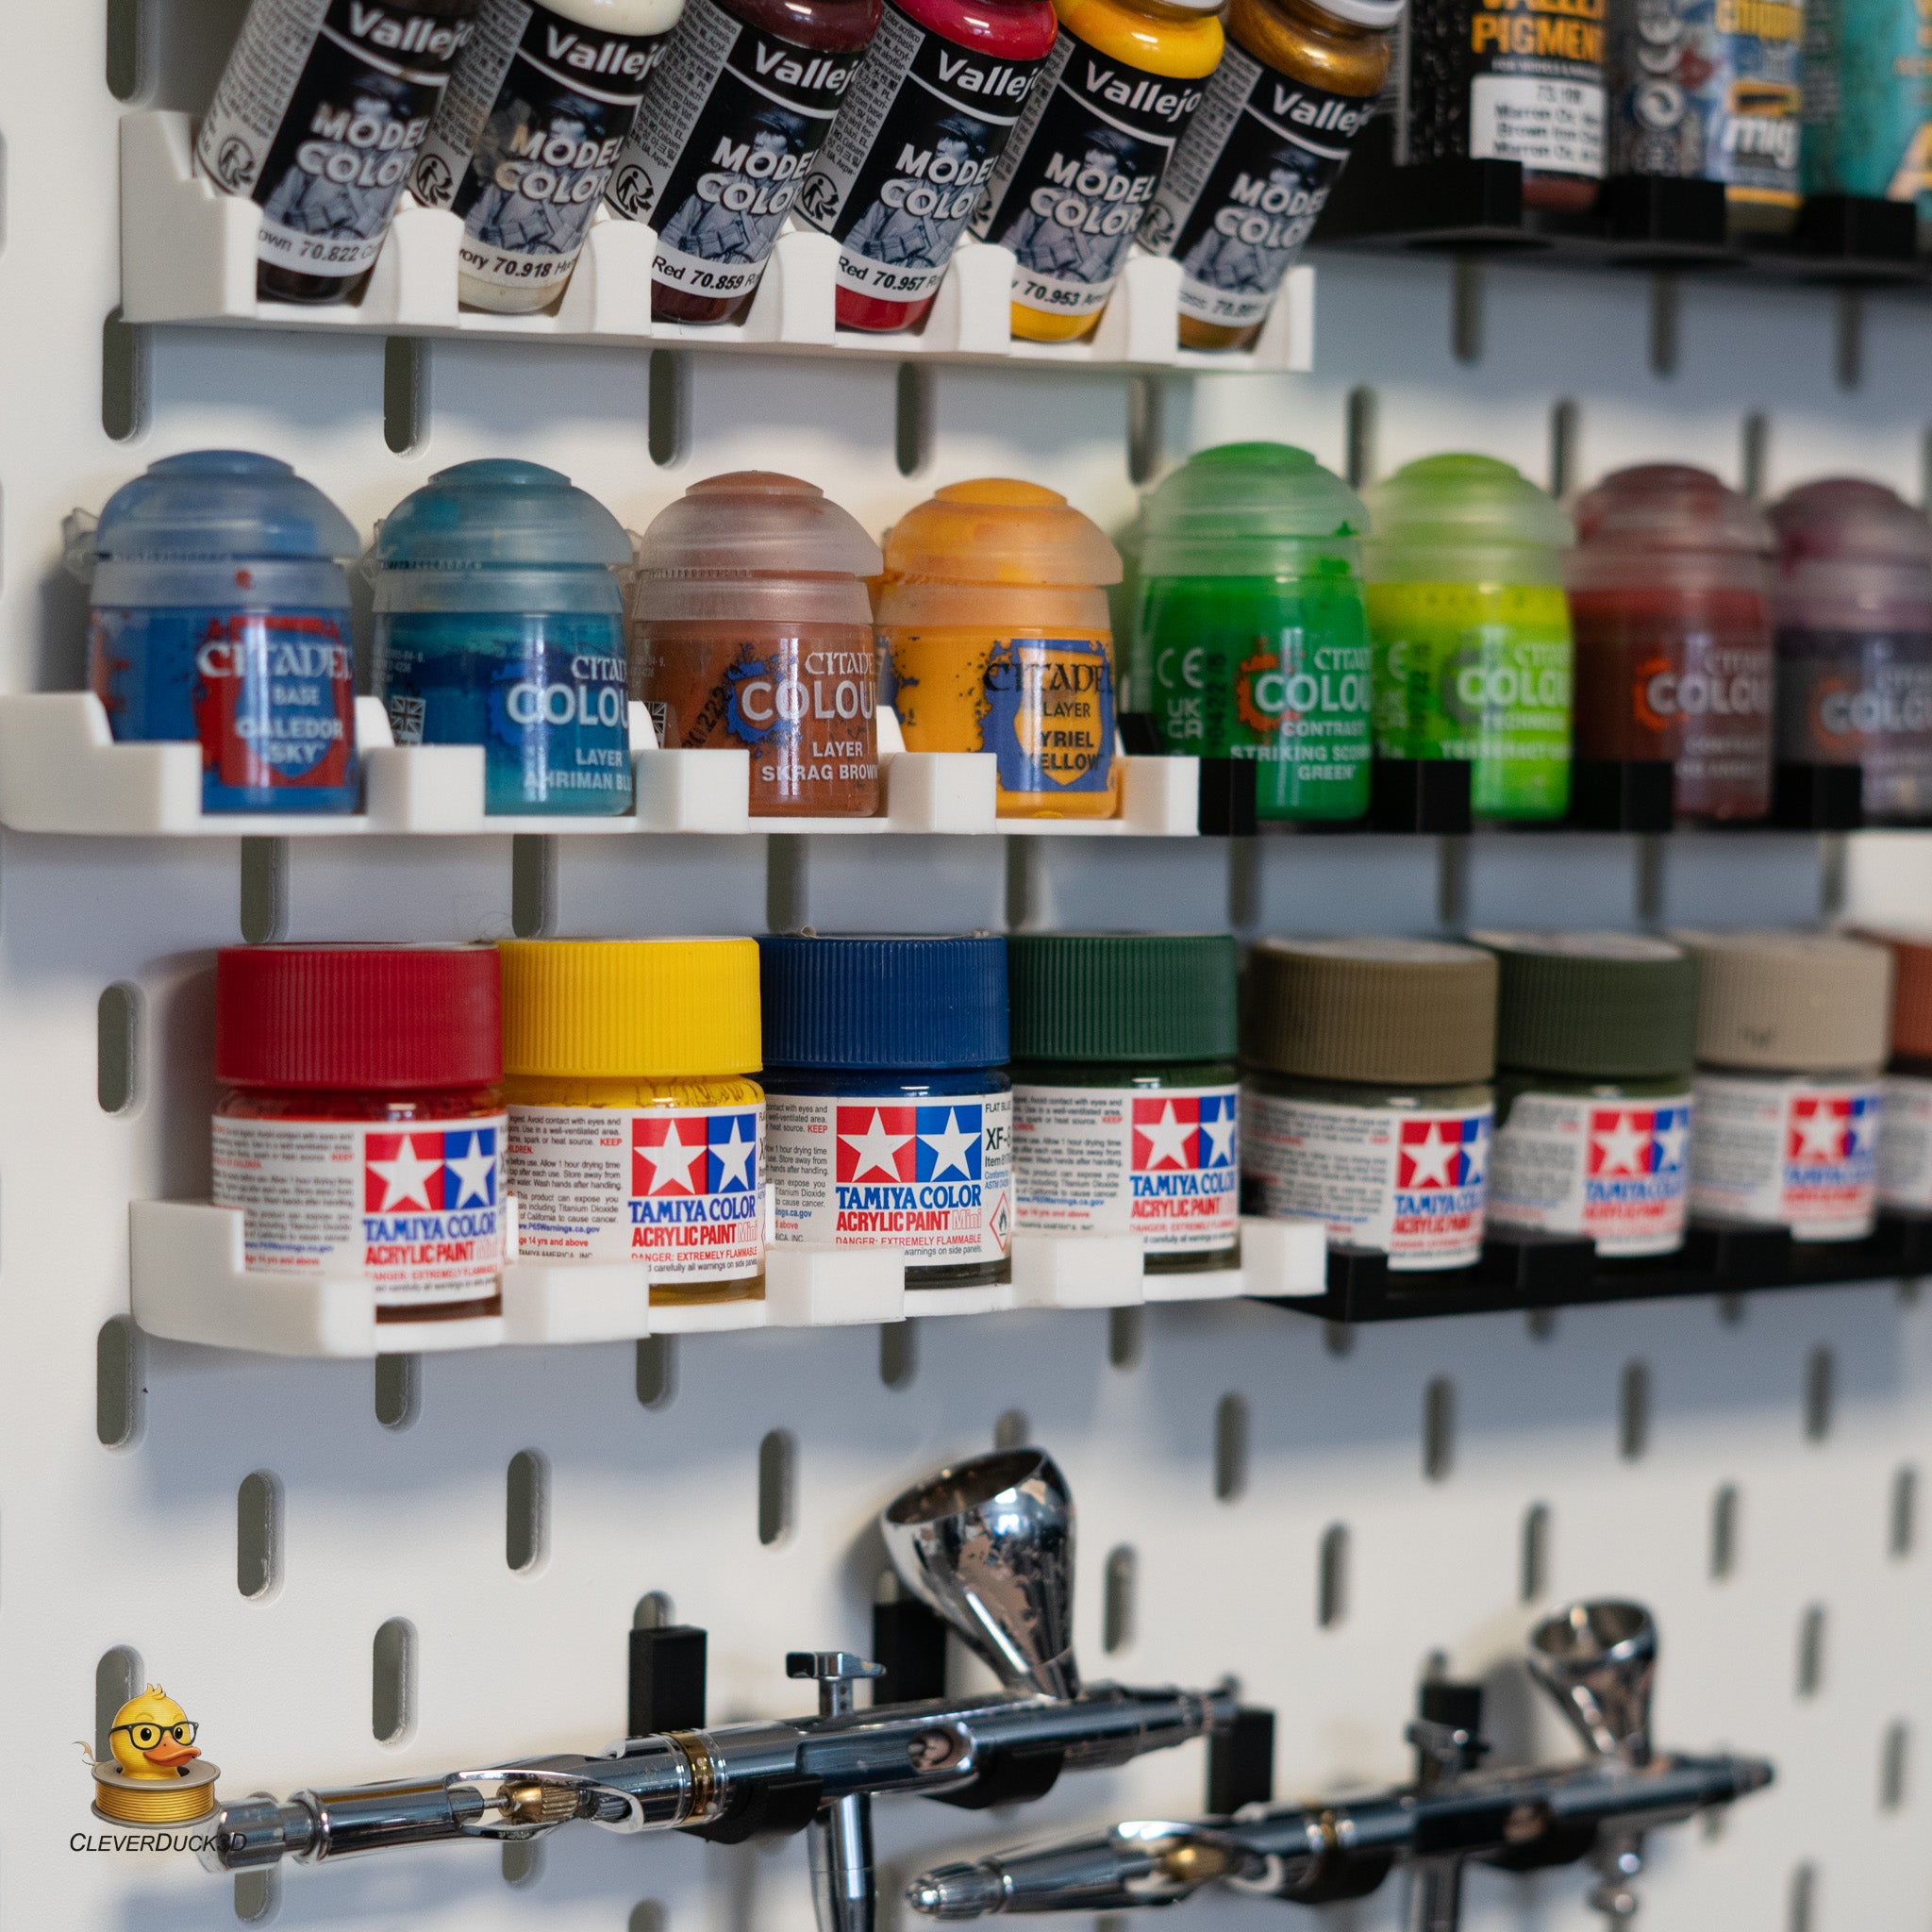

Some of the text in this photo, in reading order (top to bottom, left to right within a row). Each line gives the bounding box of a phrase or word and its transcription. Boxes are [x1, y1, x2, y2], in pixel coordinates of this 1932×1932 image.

[1084, 59, 1200, 123] Vallejo
[868, 105, 883, 120] base
[310, 101, 431, 151] MODEL
[508, 125, 625, 169] MODEL
[495, 159, 613, 204] COLOR
[1043, 152, 1156, 204] MODEL
[1030, 186, 1144, 237] COLOR
[1214, 206, 1314, 249] COLO
[300, 242, 359, 263] 70.822
[492, 258, 552, 278] 70.918
[652, 256, 685, 279] Red
[690, 270, 744, 291] 70.859
[838, 256, 868, 279] Red
[873, 270, 926, 291] 70.957
[1024, 281, 1082, 307] 70.953
[1043, 702, 1091, 718] LAYER
[1040, 730, 1095, 749] YRIEL
[575, 748, 623, 767] LAYER
[812, 741, 863, 758] LAYER
[1229, 744, 1327, 762] STRIKING
[1028, 753, 1101, 771] ELLOW
[524, 770, 613, 791] AHRIMAN
[761, 764, 879, 782] SKRAG BROWN
[1297, 764, 1357, 782] GREEN
[985, 1102, 1000, 1113] FLAT
[808, 1124, 828, 1133] KEEP
[599, 1138, 623, 1146] KEEP
[793, 1145, 812, 1156] drying
[581, 1160, 603, 1170] drying
[794, 1158, 811, 1166] away
[984, 1156, 1001, 1167] Item
[563, 1170, 581, 1178] Store
[552, 1180, 589, 1189] hands after
[801, 1189, 825, 1197] Dioxide
[1129, 1174, 1199, 1197] TAMIYA
[531, 1193, 554, 1202] product
[835, 1184, 982, 1210] TAMIYA COLOR
[1393, 1193, 1457, 1216] TAMIYA
[558, 1204, 619, 1213] Titanium Dioxide
[627, 1194, 756, 1224] TAMIYA COLOR
[1132, 1199, 1189, 1219] ACRYLIC
[1191, 1197, 1222, 1217] PAINT
[836, 1208, 982, 1232] ACRYLIC PAINT Mini
[362, 1217, 444, 1242] TAMIYA
[631, 1221, 758, 1247] ACRYLIC PAINT Mini
[550, 1238, 590, 1247] and above
[881, 1236, 934, 1246] EXTREMELY
[937, 1233, 982, 1244] FLAMMABLE
[365, 1241, 475, 1265] ACRYLIC PAINT
[676, 1250, 724, 1262] EXTREMELY
[725, 1246, 758, 1259] FLAMMABLE
[939, 1247, 947, 1256] on
[948, 1245, 962, 1255] side
[963, 1244, 983, 1256] panels.
[654, 1262, 686, 1273] carefully
[688, 1262, 696, 1271] all
[697, 1261, 725, 1272] warnings
[735, 1259, 744, 1268] side
